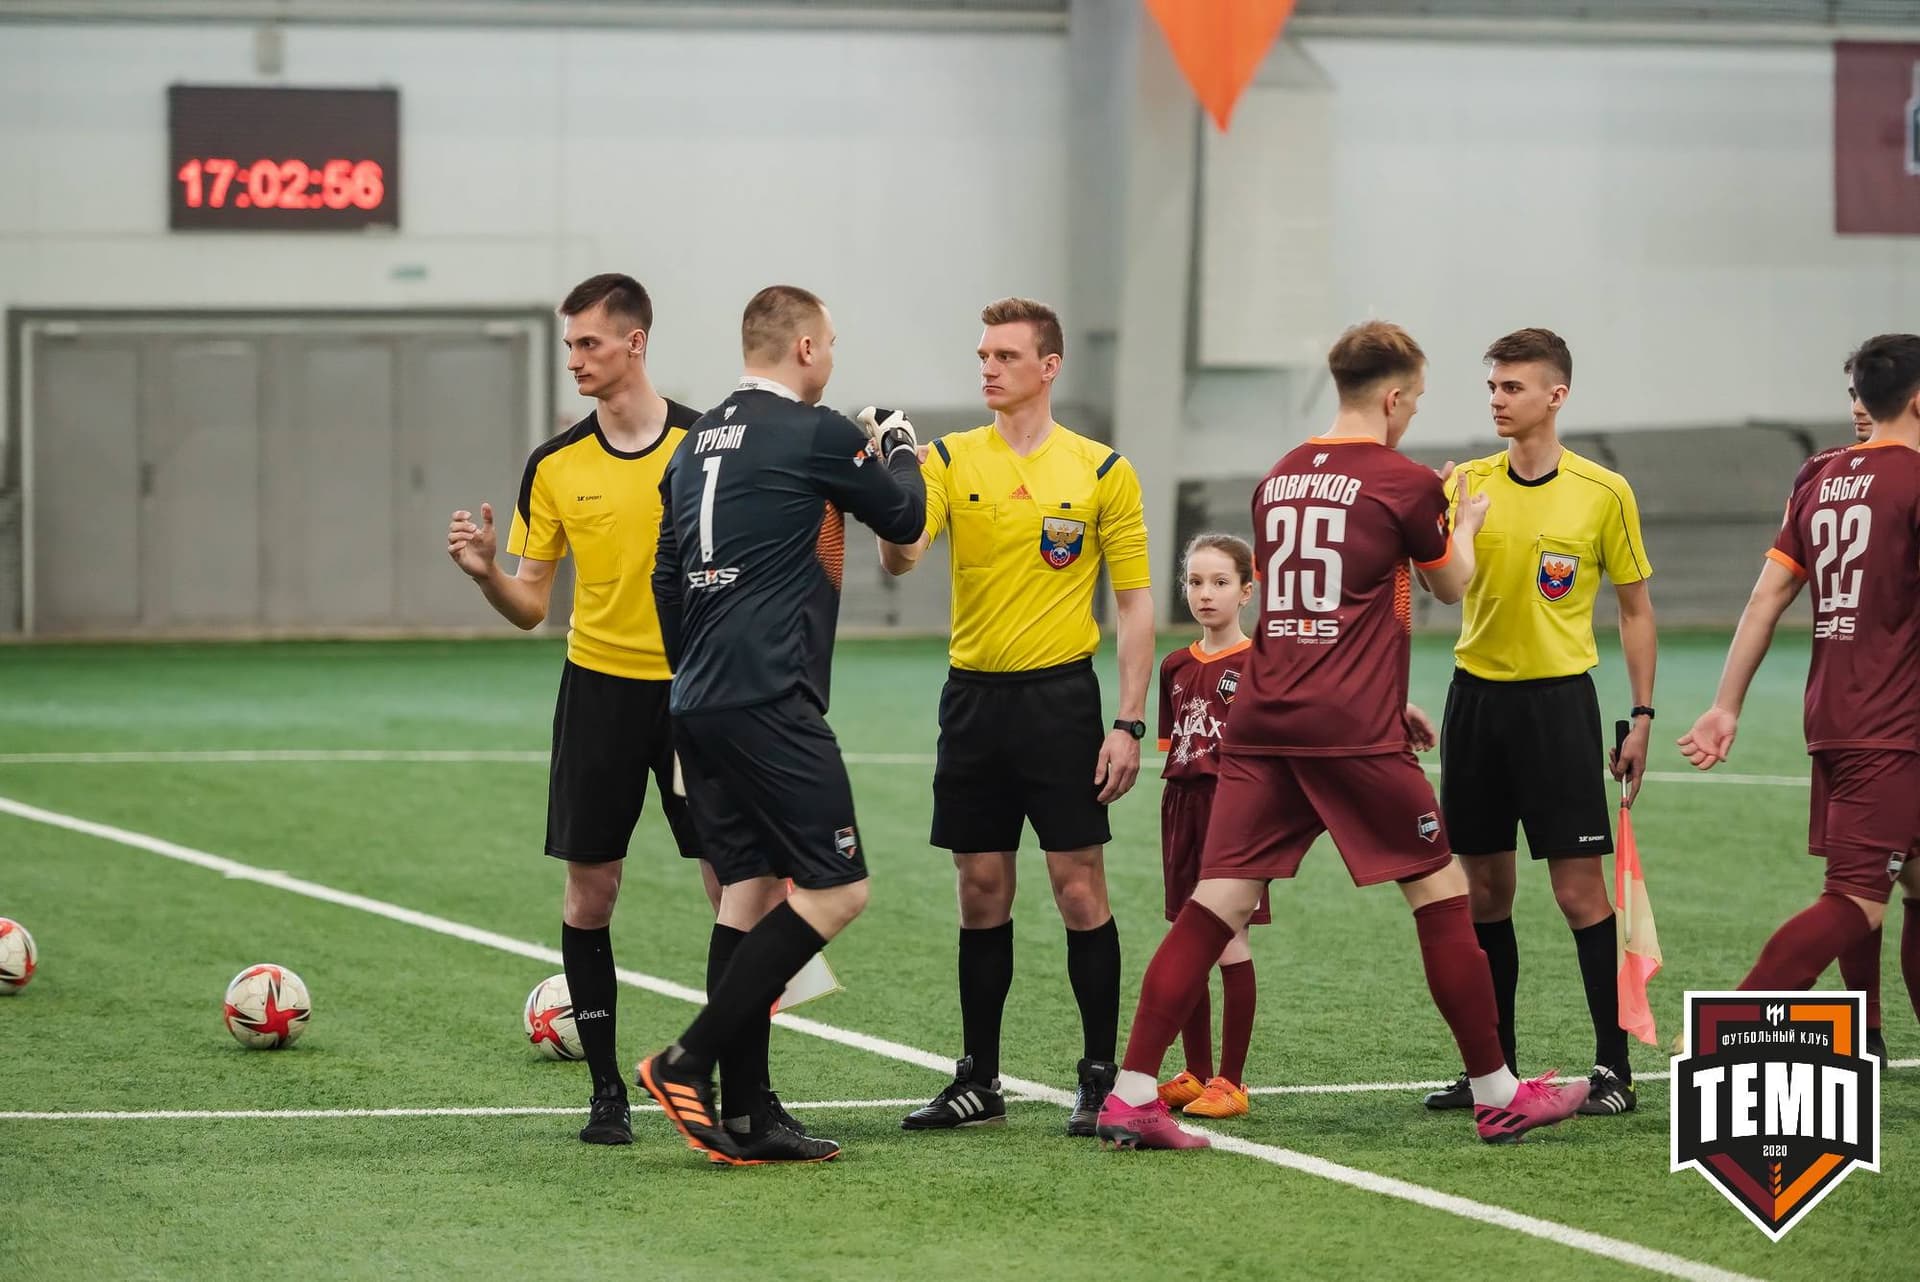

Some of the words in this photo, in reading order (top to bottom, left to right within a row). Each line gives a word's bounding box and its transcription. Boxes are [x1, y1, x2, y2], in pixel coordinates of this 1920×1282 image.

[178, 158, 384, 209] 17:02:56
[694, 424, 747, 455] ТРУБИН
[700, 456, 723, 563] 1
[1263, 473, 1362, 506] НОВИЧКОВ
[1819, 474, 1875, 503] БАБИЧ
[1266, 506, 1347, 612] 25
[1811, 504, 1872, 613] 22
